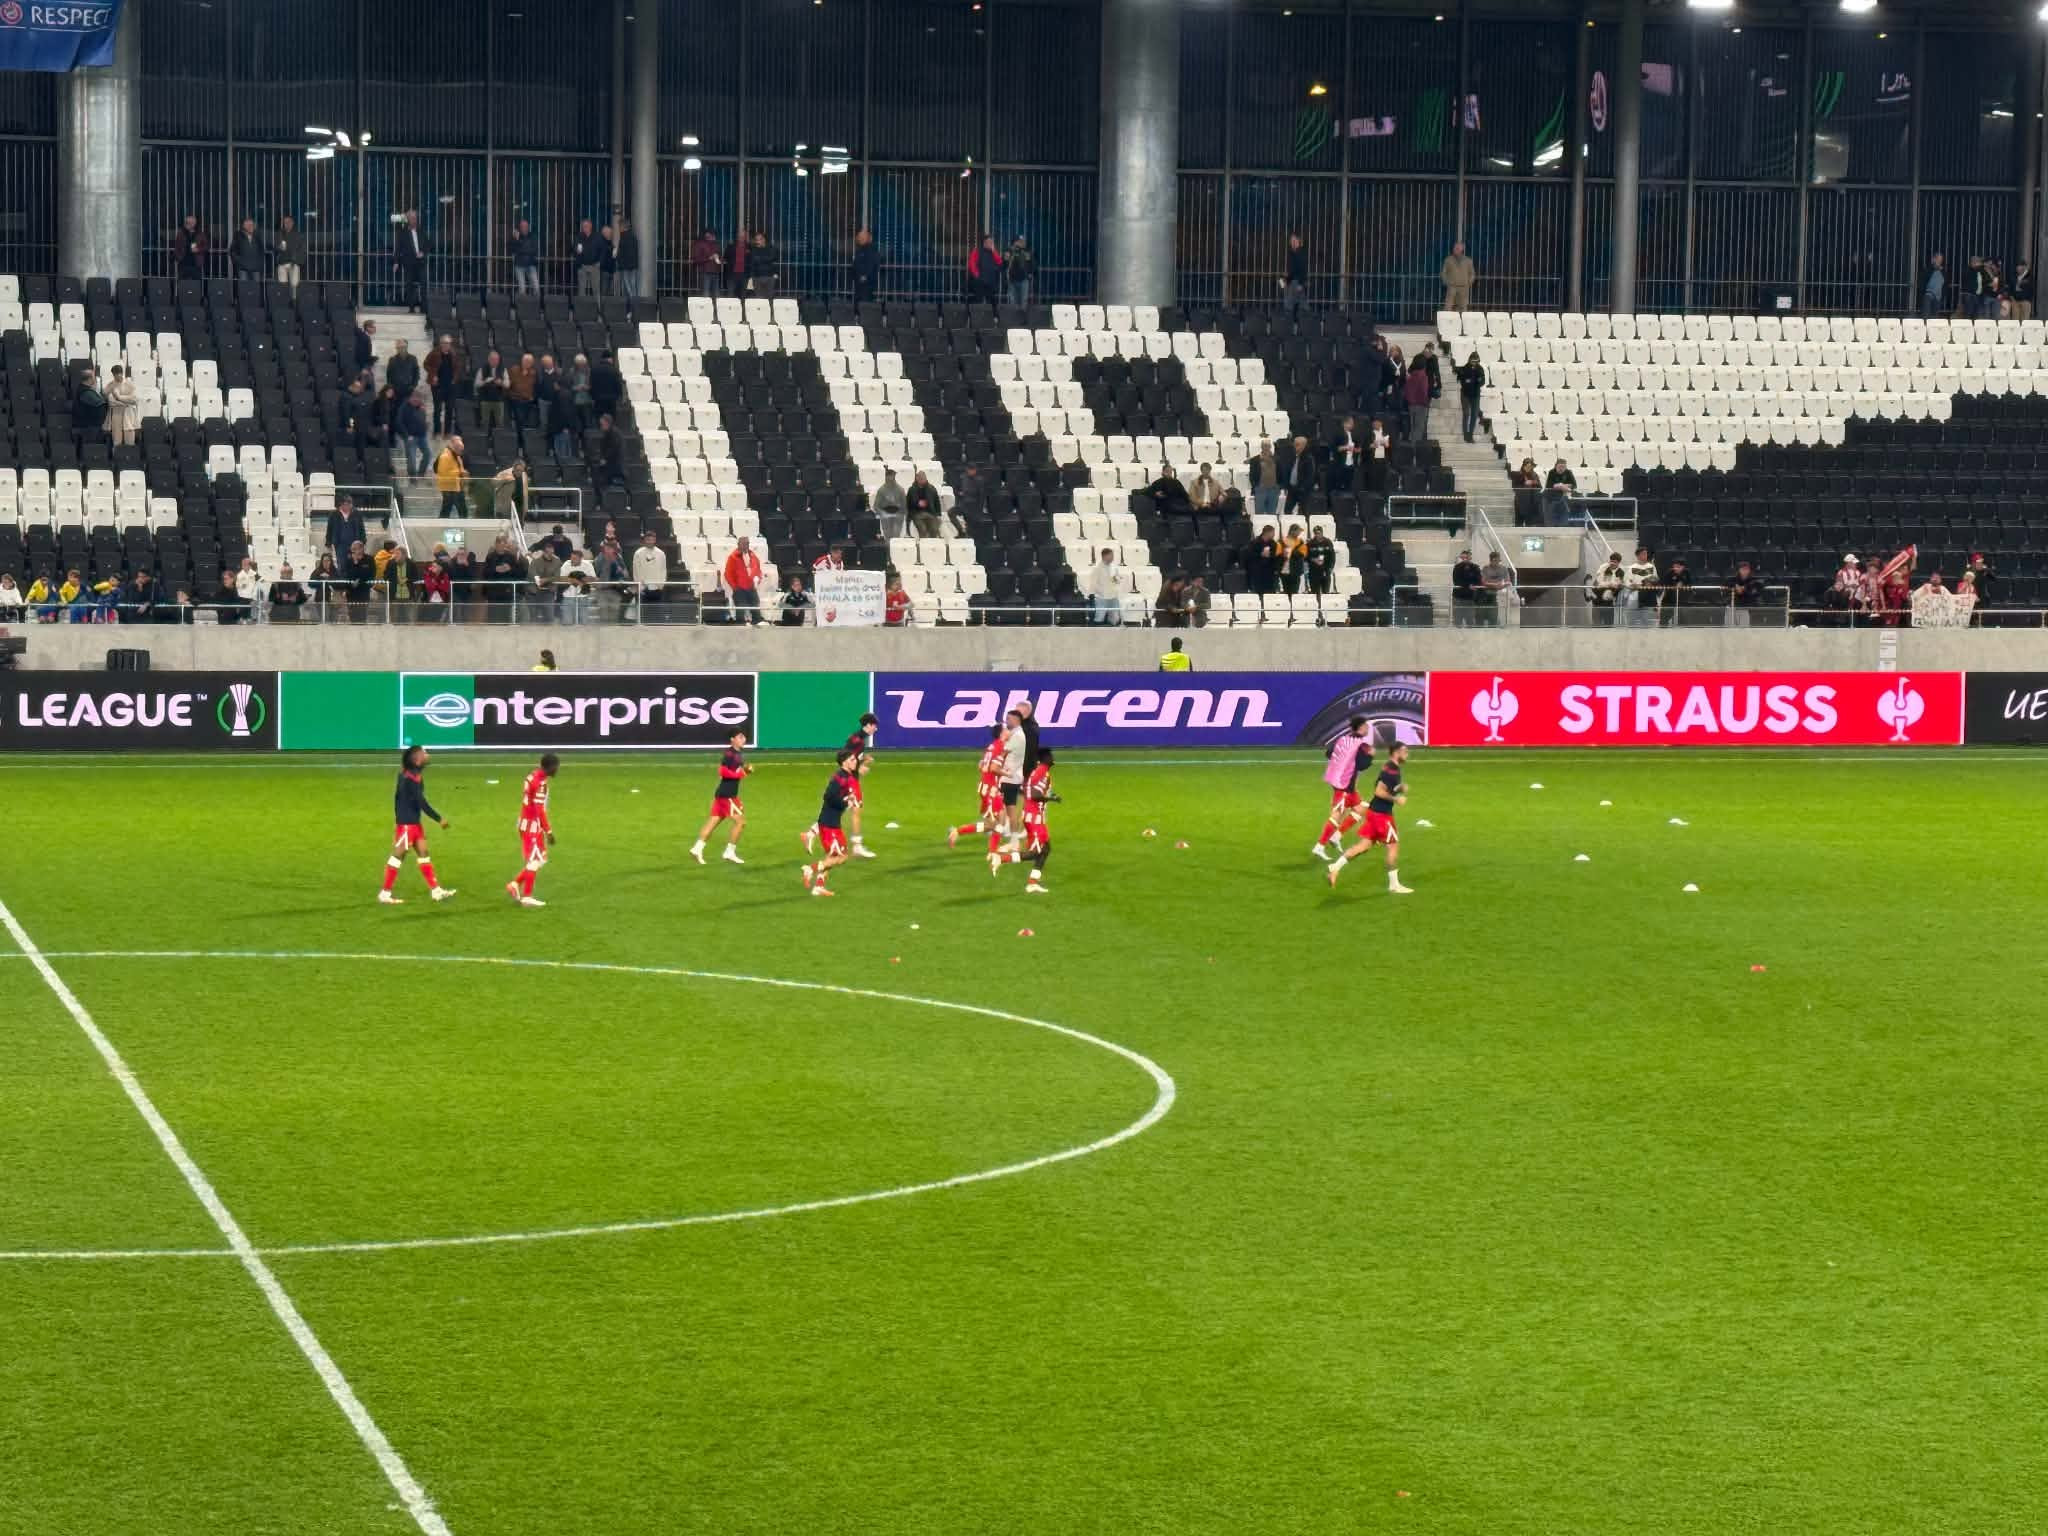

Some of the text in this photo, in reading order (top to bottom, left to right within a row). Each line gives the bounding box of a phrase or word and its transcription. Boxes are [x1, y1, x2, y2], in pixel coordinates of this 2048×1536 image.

[19, 693, 193, 727] LEAGUE
[424, 687, 749, 736] enterprise
[885, 689, 1283, 729] Laufenn
[1558, 684, 1838, 735] STRAUSS
